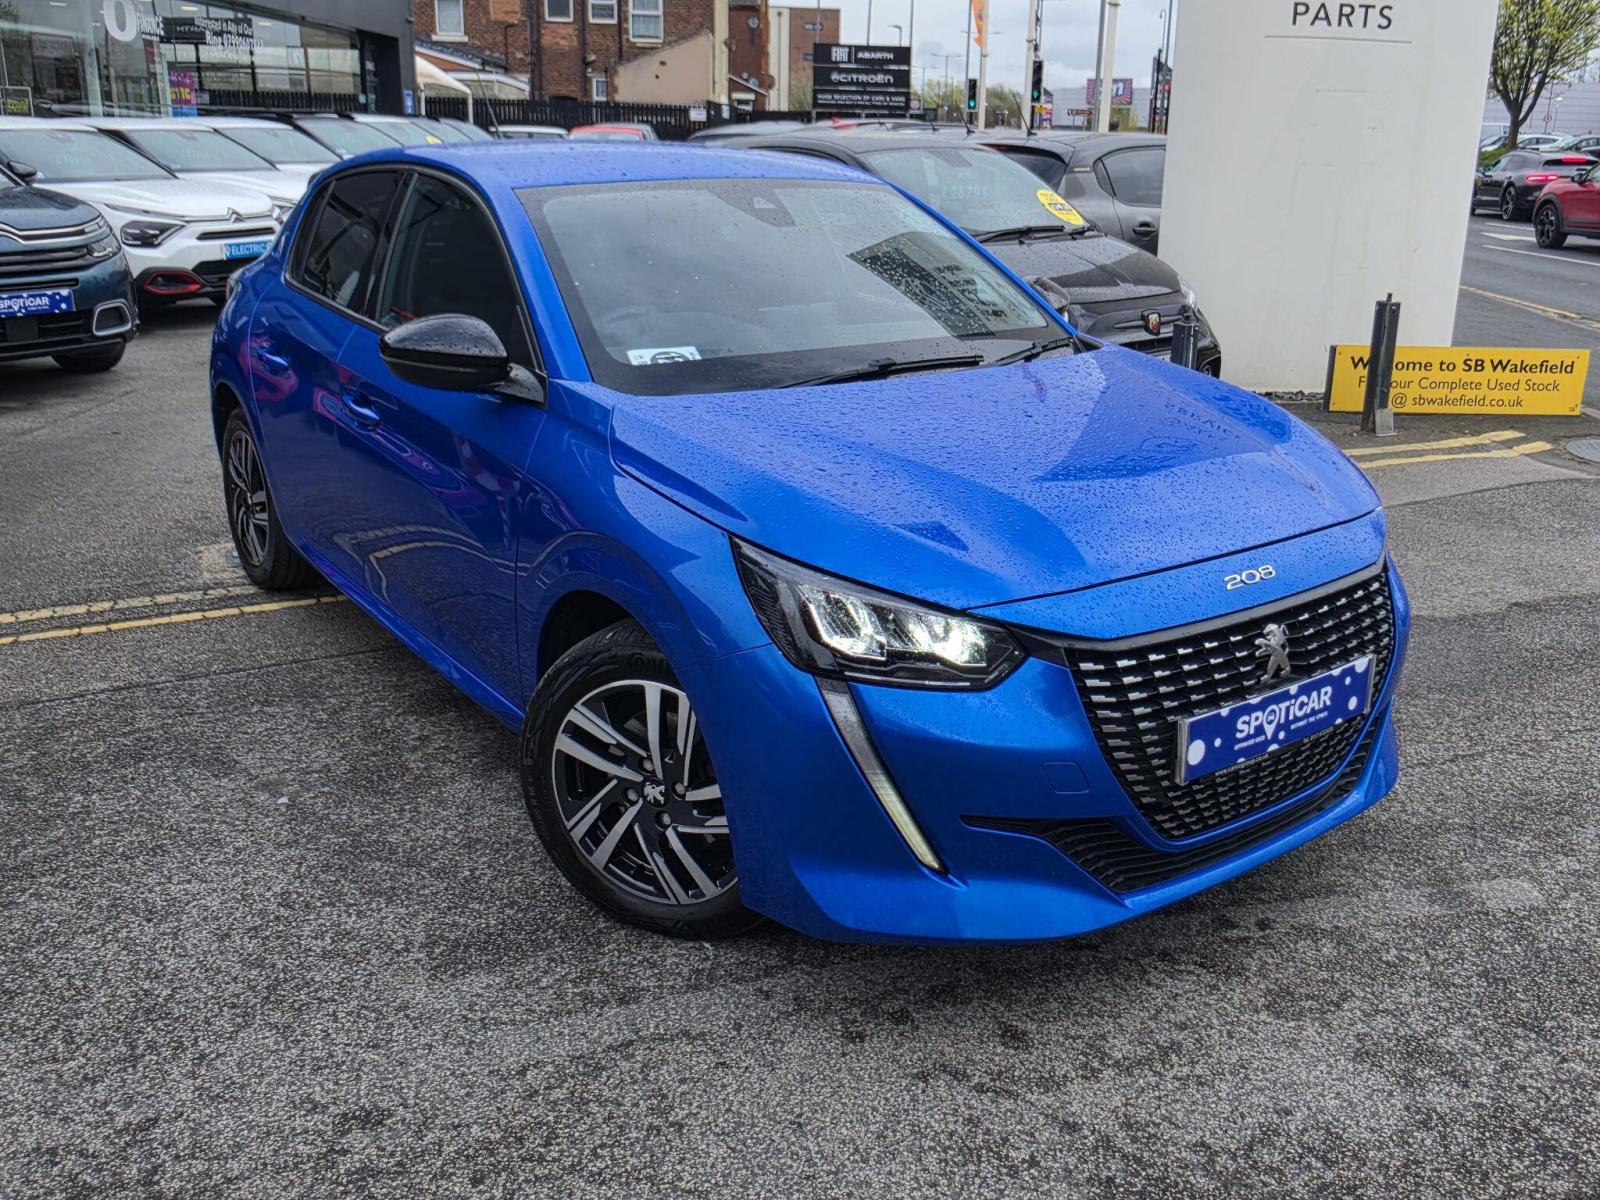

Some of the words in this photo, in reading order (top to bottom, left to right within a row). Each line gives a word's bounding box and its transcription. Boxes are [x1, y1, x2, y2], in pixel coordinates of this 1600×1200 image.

[1292, 2, 1394, 30] PARTS
[831, 46, 850, 62] FIAT
[857, 50, 894, 60] ABARTH
[231, 243, 265, 255] ELECTRIC
[1350, 355, 1433, 372] Wome
[1438, 358, 1456, 373] to
[1462, 358, 1485, 373] SB
[1490, 358, 1574, 375] Wakefield
[1418, 377, 1482, 394] Complete
[1486, 378, 1520, 392] Used
[1524, 378, 1560, 393] Stock
[1391, 392, 1407, 408] @
[1411, 394, 1524, 408] sbwakefield.co.uk
[1223, 564, 1276, 591] 208
